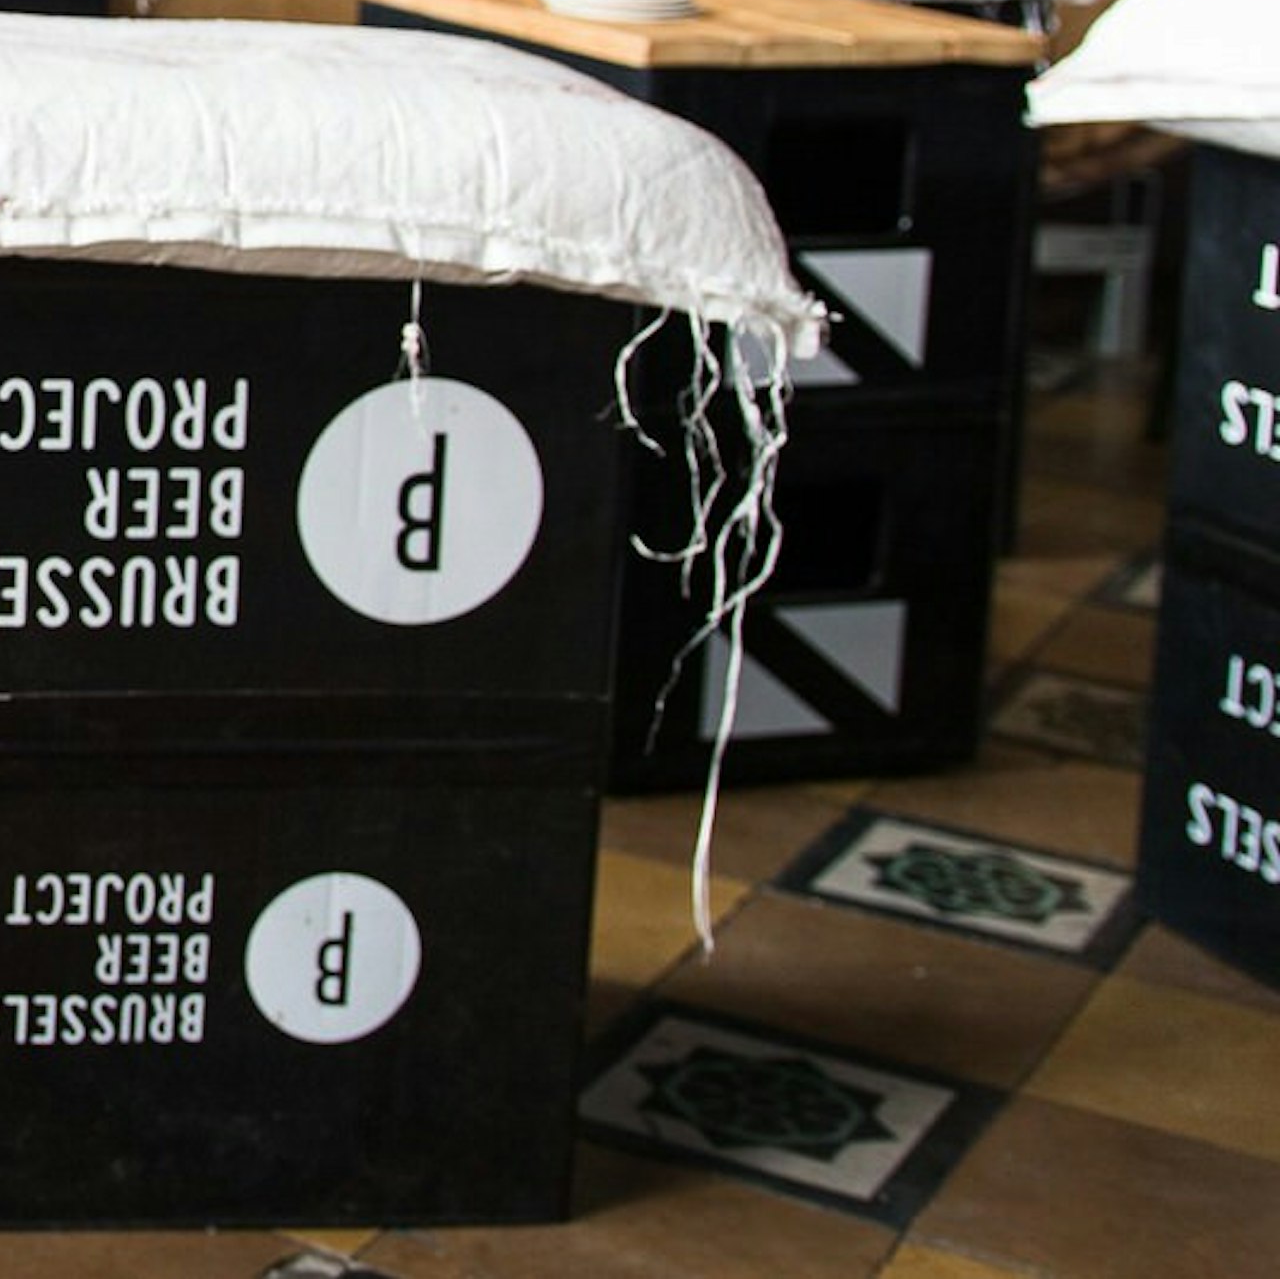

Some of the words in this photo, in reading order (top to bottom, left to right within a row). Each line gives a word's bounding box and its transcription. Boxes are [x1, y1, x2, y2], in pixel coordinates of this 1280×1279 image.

[84, 467, 244, 540] BEER
[5, 873, 214, 925] PROJECT
[95, 933, 210, 984] BEER
